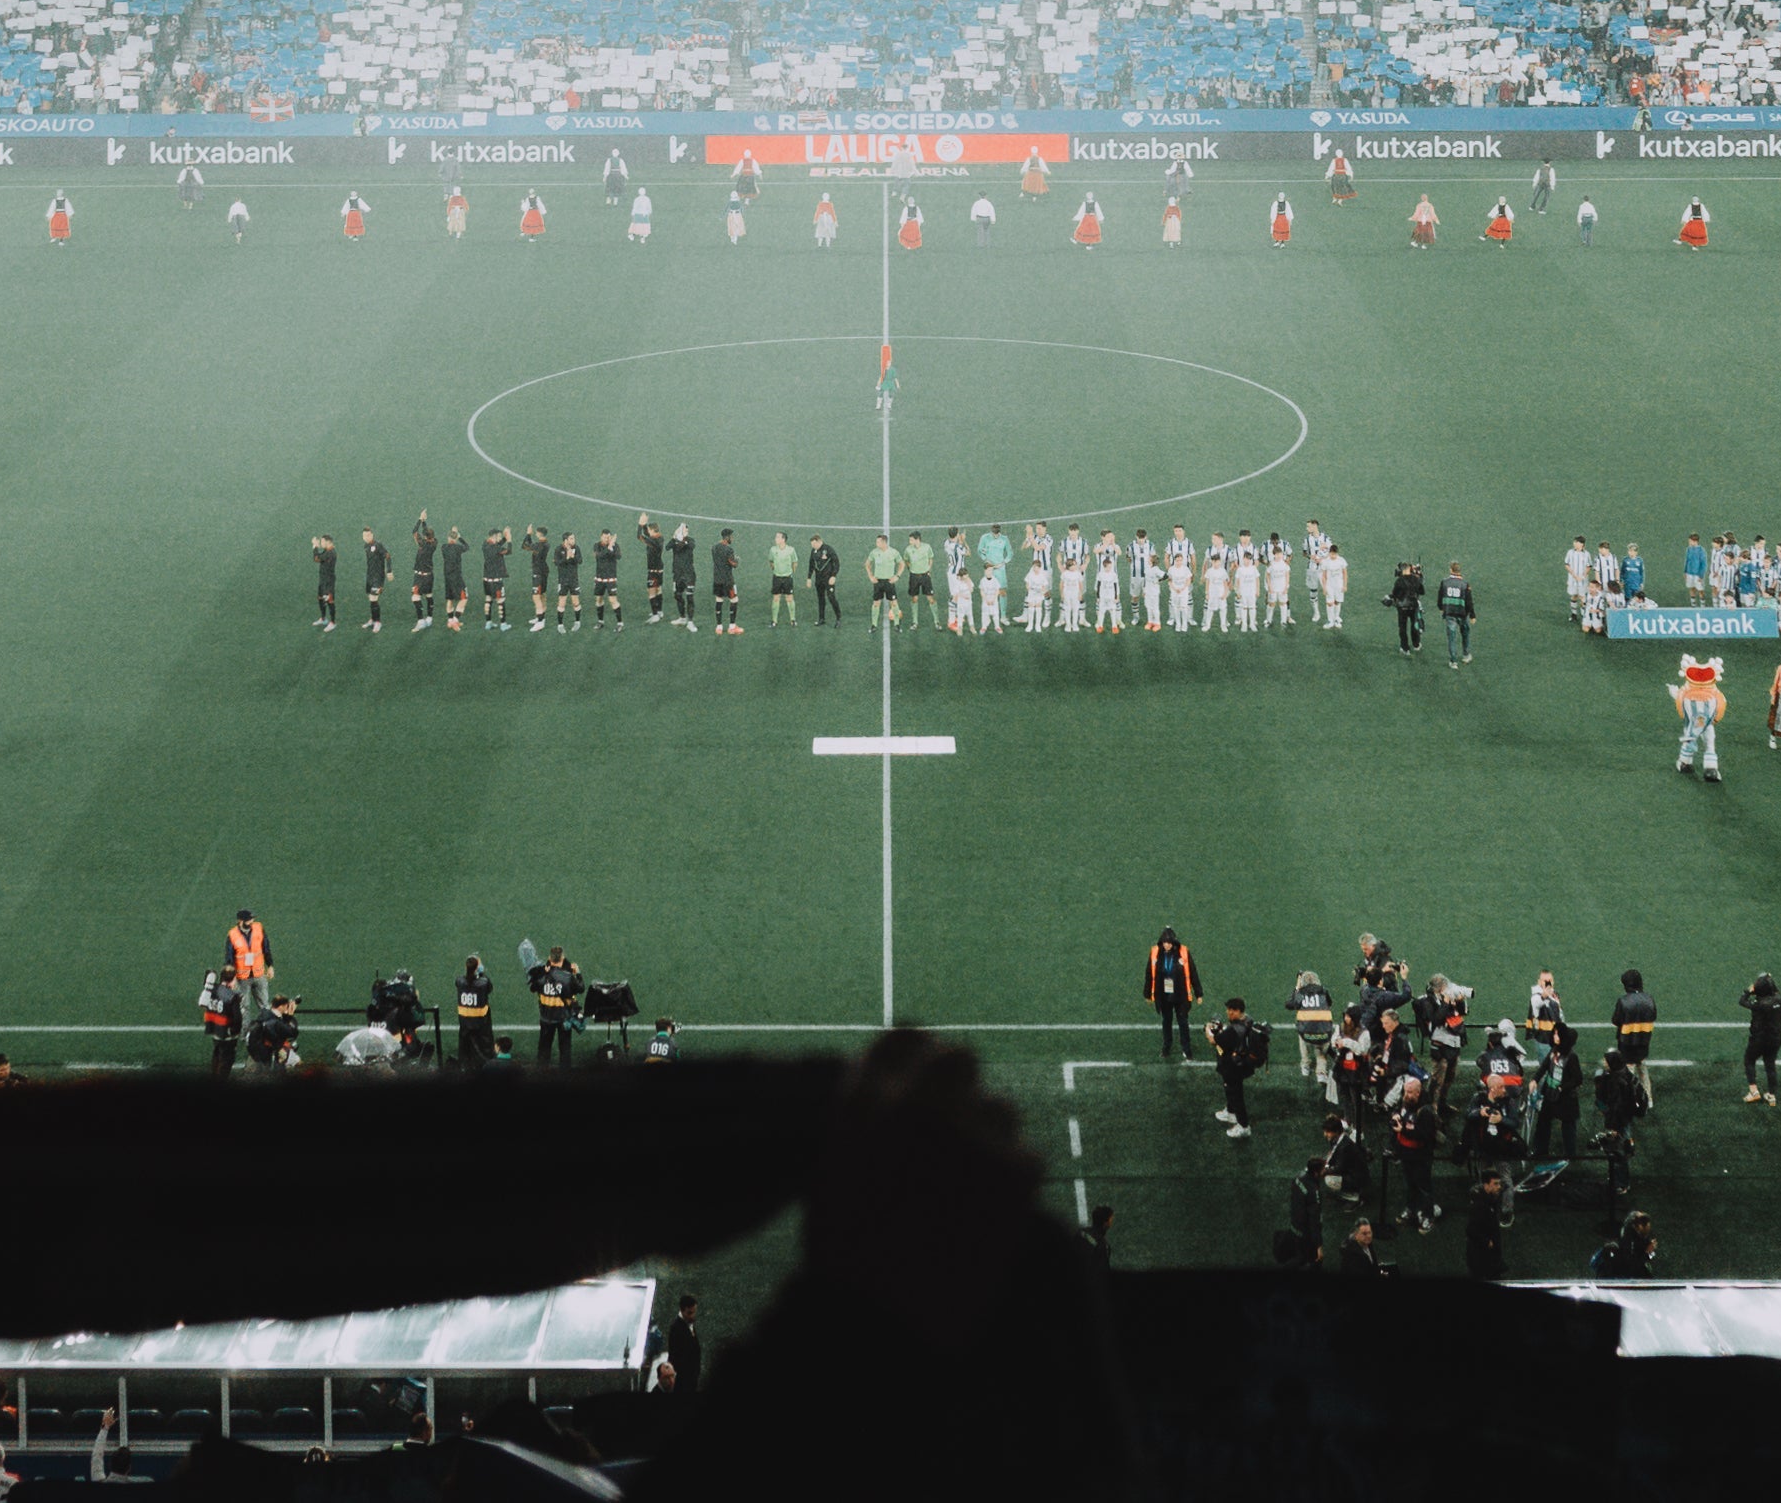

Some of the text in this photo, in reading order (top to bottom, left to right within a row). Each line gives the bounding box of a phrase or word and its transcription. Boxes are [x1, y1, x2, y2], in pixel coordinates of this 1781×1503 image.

[387, 115, 460, 130] YASUDA
[571, 115, 645, 130] YASUDA
[777, 111, 995, 131] REAL SOCIEDAD
[1335, 111, 1411, 126] YASUDA
[149, 140, 295, 165] kutxabank
[1073, 137, 1219, 160] kutxabank
[1356, 135, 1502, 159] kutxabank
[1627, 611, 1757, 636] kutxabank
